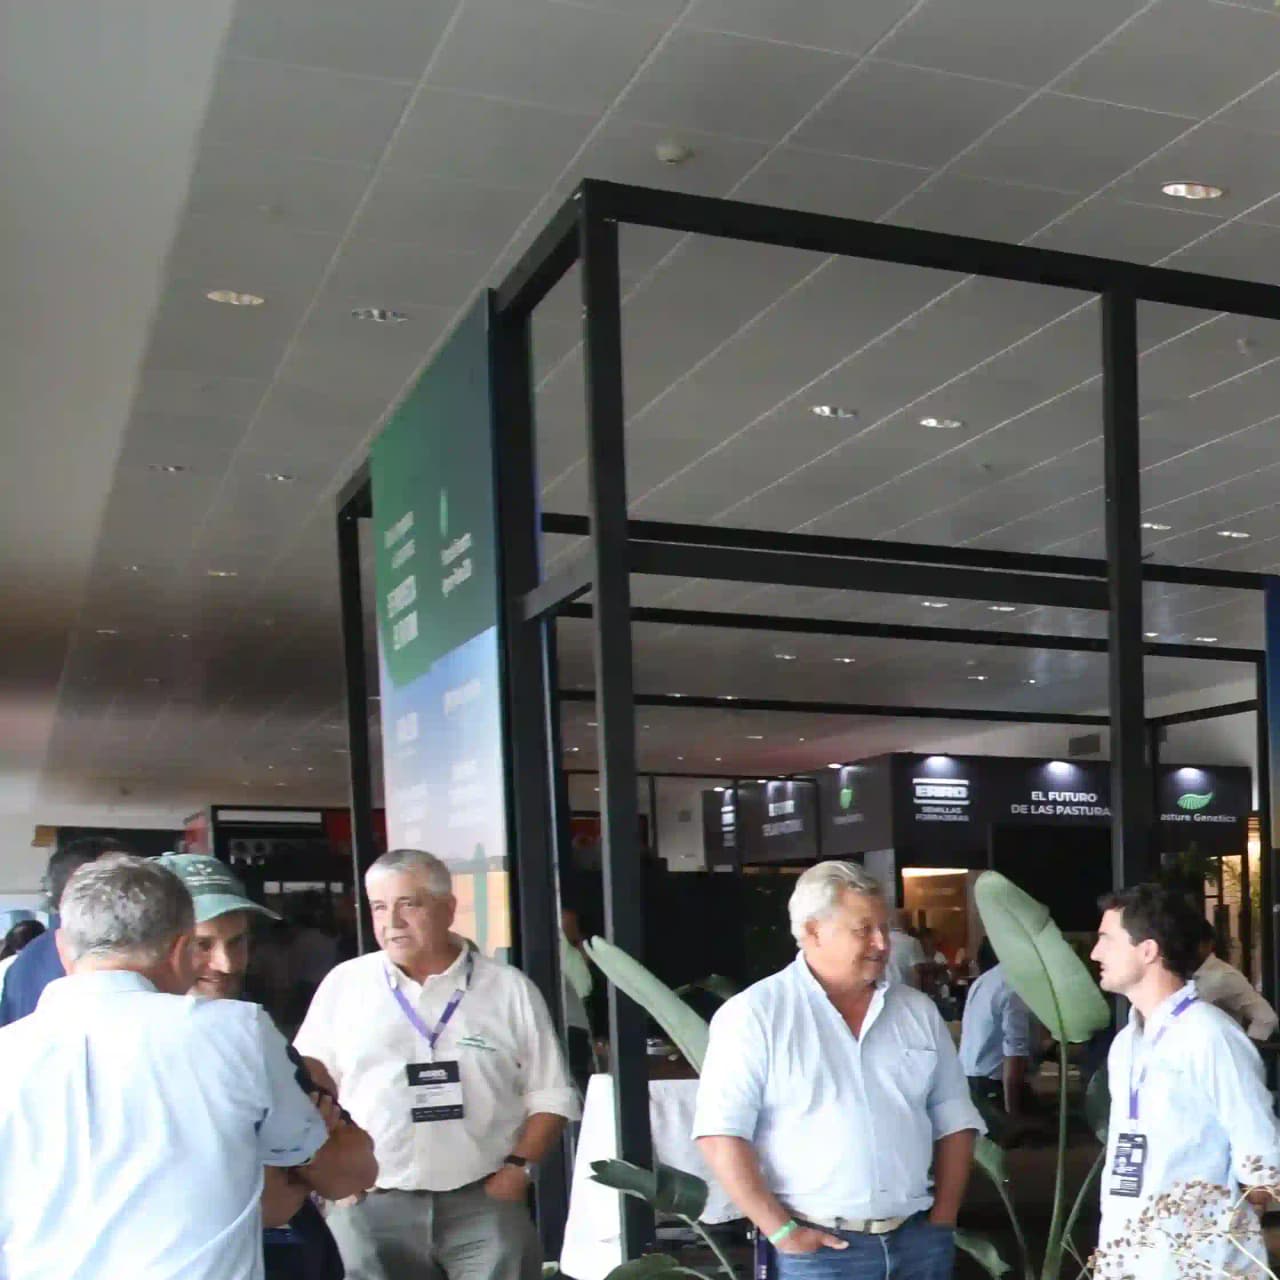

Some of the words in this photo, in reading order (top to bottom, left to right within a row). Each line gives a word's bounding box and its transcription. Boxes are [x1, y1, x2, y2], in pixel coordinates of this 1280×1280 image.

[1031, 791, 1046, 801] EL
[1048, 791, 1098, 803] FUTURO
[1011, 804, 1028, 814] DE
[1031, 804, 1055, 815] LAS
[1056, 805, 1112, 817] PASTURA
[1160, 813, 1191, 822] asture
[1193, 813, 1237, 823] Genetics
